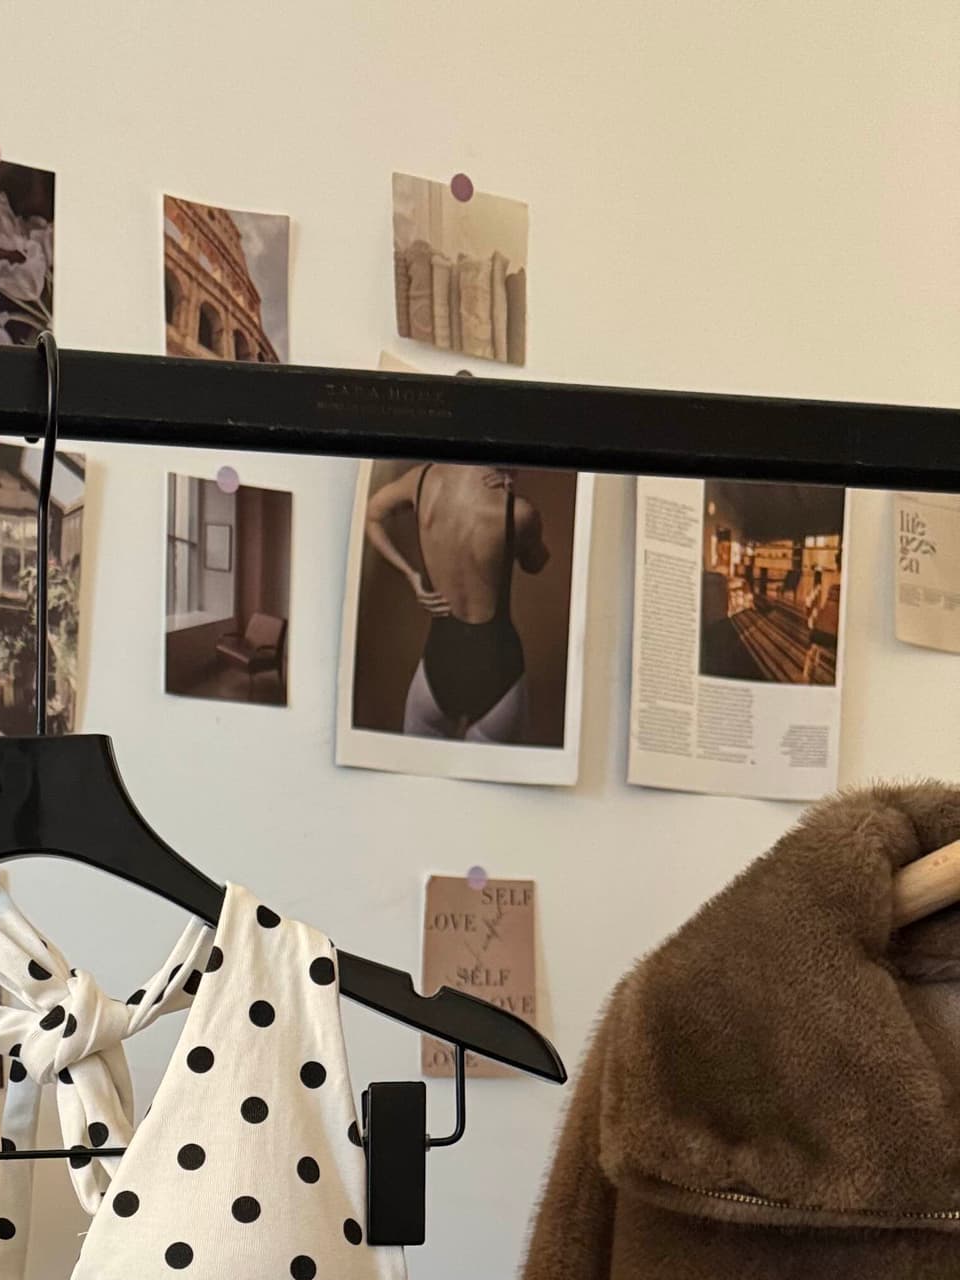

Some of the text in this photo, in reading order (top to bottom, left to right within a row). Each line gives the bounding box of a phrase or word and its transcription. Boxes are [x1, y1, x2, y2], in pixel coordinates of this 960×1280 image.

[481, 887, 534, 906] SELF
[456, 968, 511, 986] SELF
[491, 995, 534, 1014] OVE
